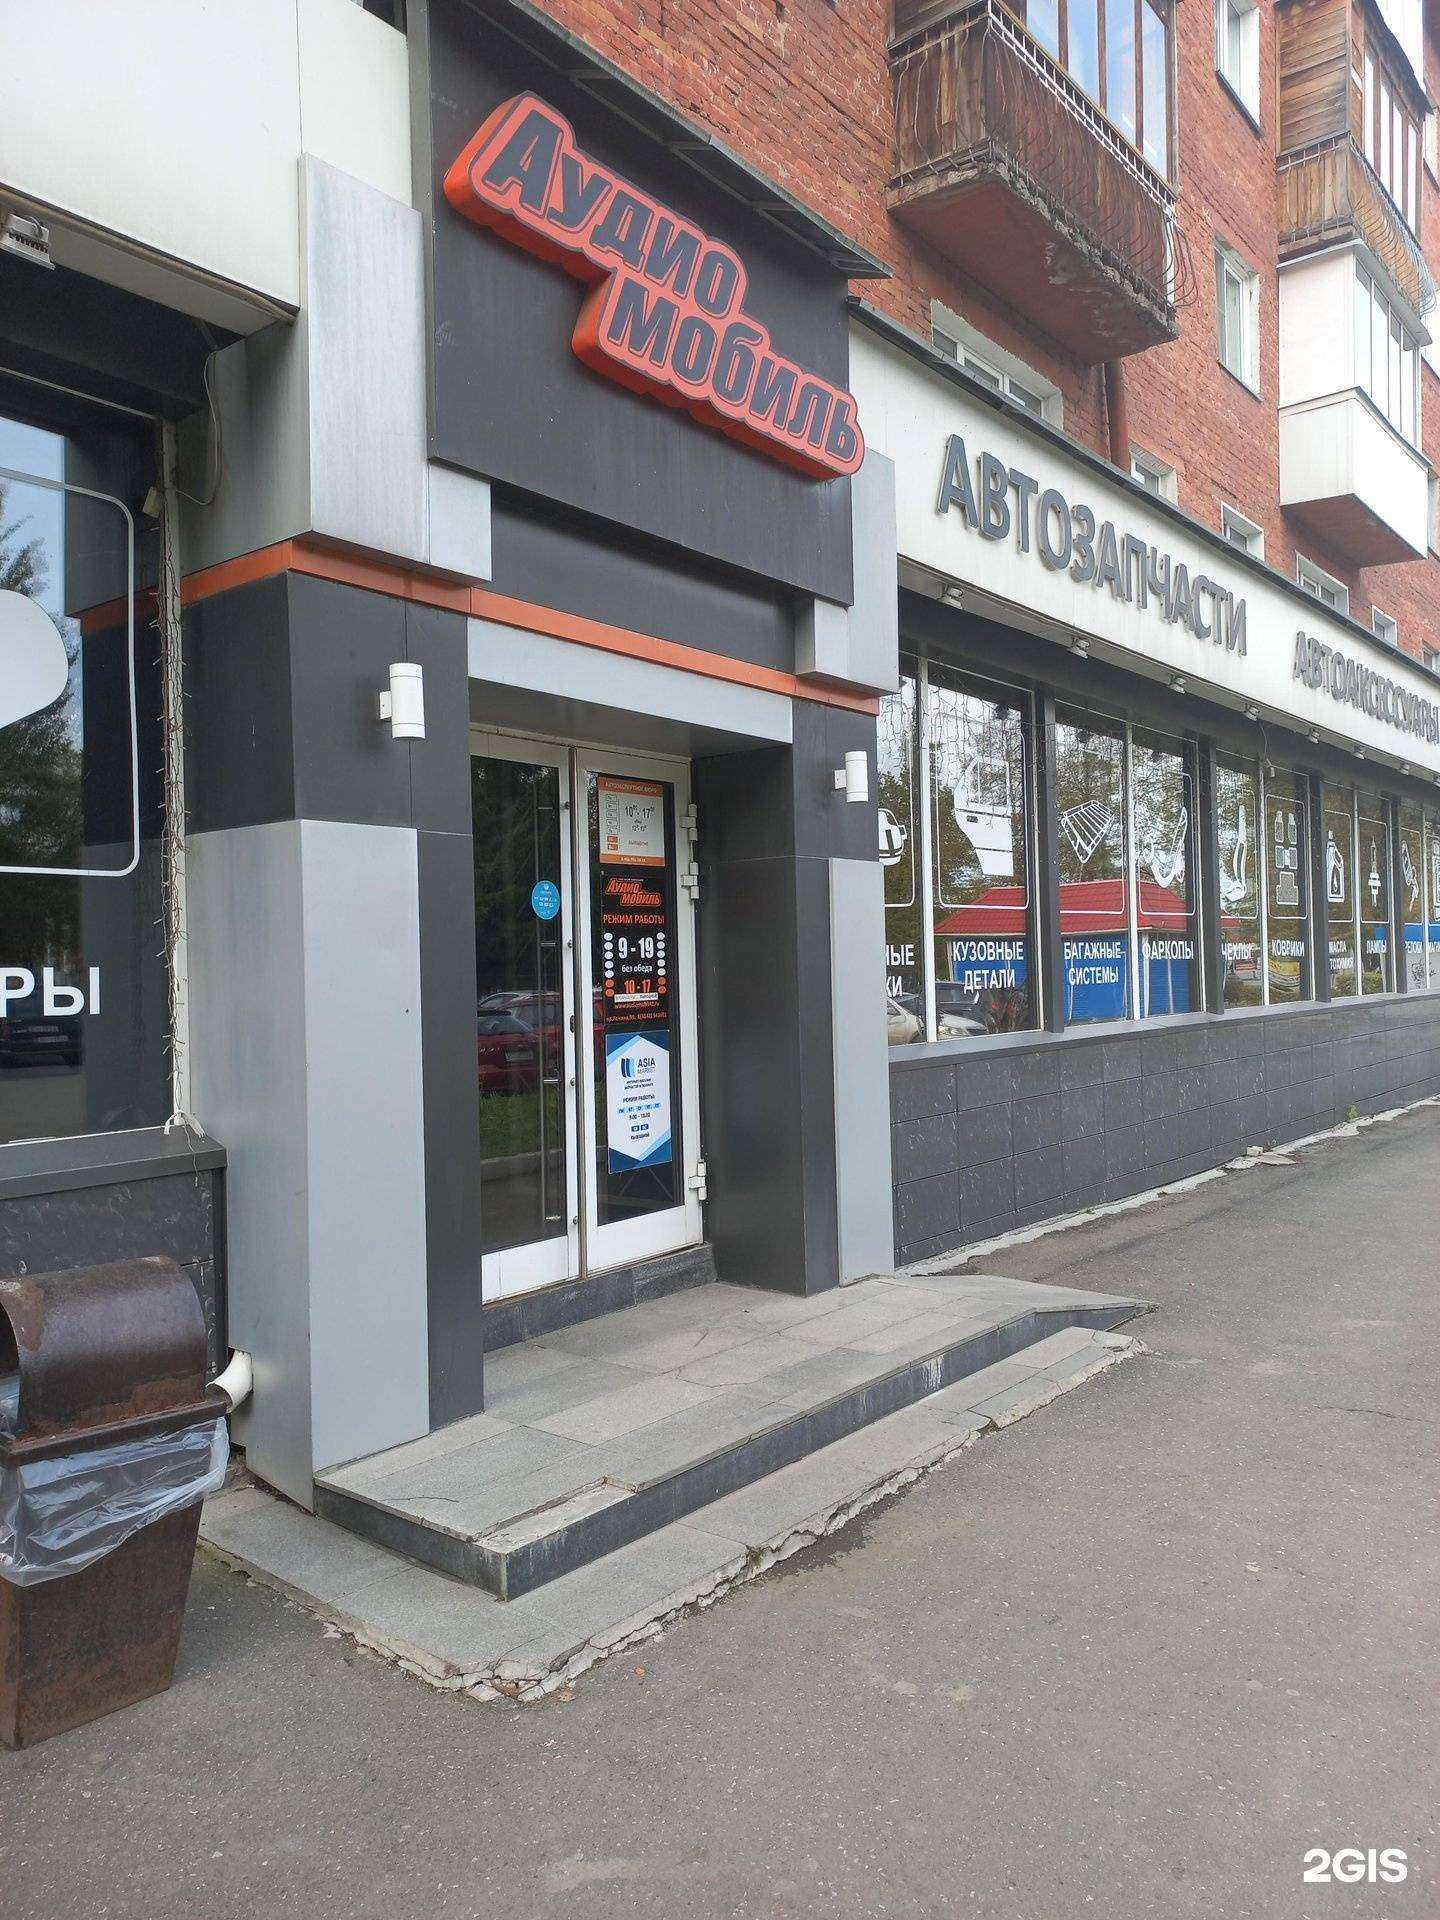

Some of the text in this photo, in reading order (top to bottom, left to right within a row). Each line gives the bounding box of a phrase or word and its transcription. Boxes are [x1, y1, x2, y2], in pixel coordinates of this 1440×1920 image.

[936, 434, 1247, 657] АВТОЗАПЧАСТИ
[603, 914, 665, 924] РЕЖИМ РАБОТЫ
[618, 937, 628, 959] 9
[638, 937, 654, 959] 19
[953, 941, 1024, 961] КУЗОВНЫЕ
[1064, 941, 1121, 960] БАГАЖНЫЕ
[1142, 940, 1194, 960] ФАРКОПЫ
[1272, 940, 1305, 957] КОВРИКИ
[622, 963, 653, 974] без обеда
[1068, 967, 1119, 986] СИСТЕМЫ
[624, 980, 635, 993] 10
[642, 980, 650, 993] 17
[963, 969, 1015, 993] ДЕТАЛИ
[638, 1058, 656, 1068] ASIA
